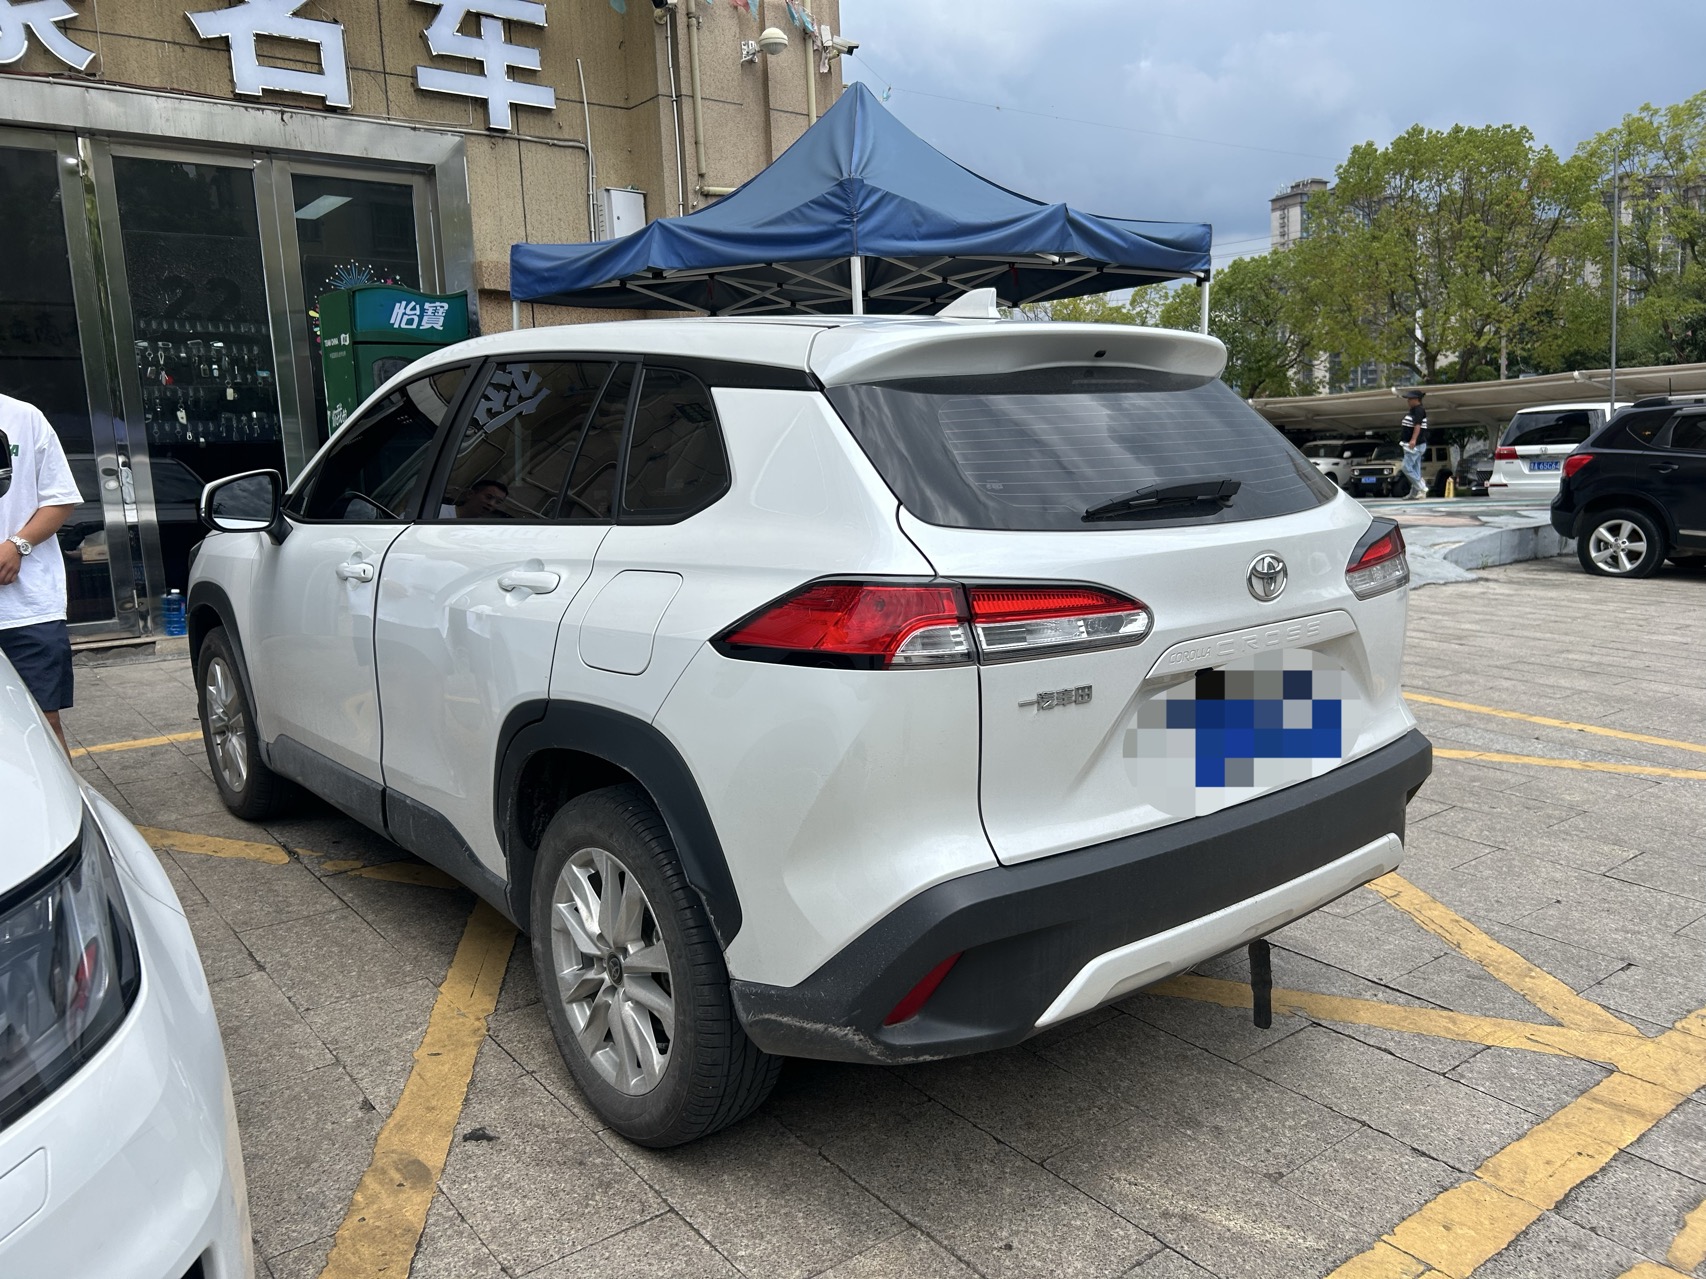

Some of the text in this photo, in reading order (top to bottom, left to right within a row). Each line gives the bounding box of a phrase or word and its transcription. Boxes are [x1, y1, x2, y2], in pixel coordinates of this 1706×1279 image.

[390, 300, 449, 331] 怡寶
[1169, 620, 1321, 665] COROLLA CROSS
